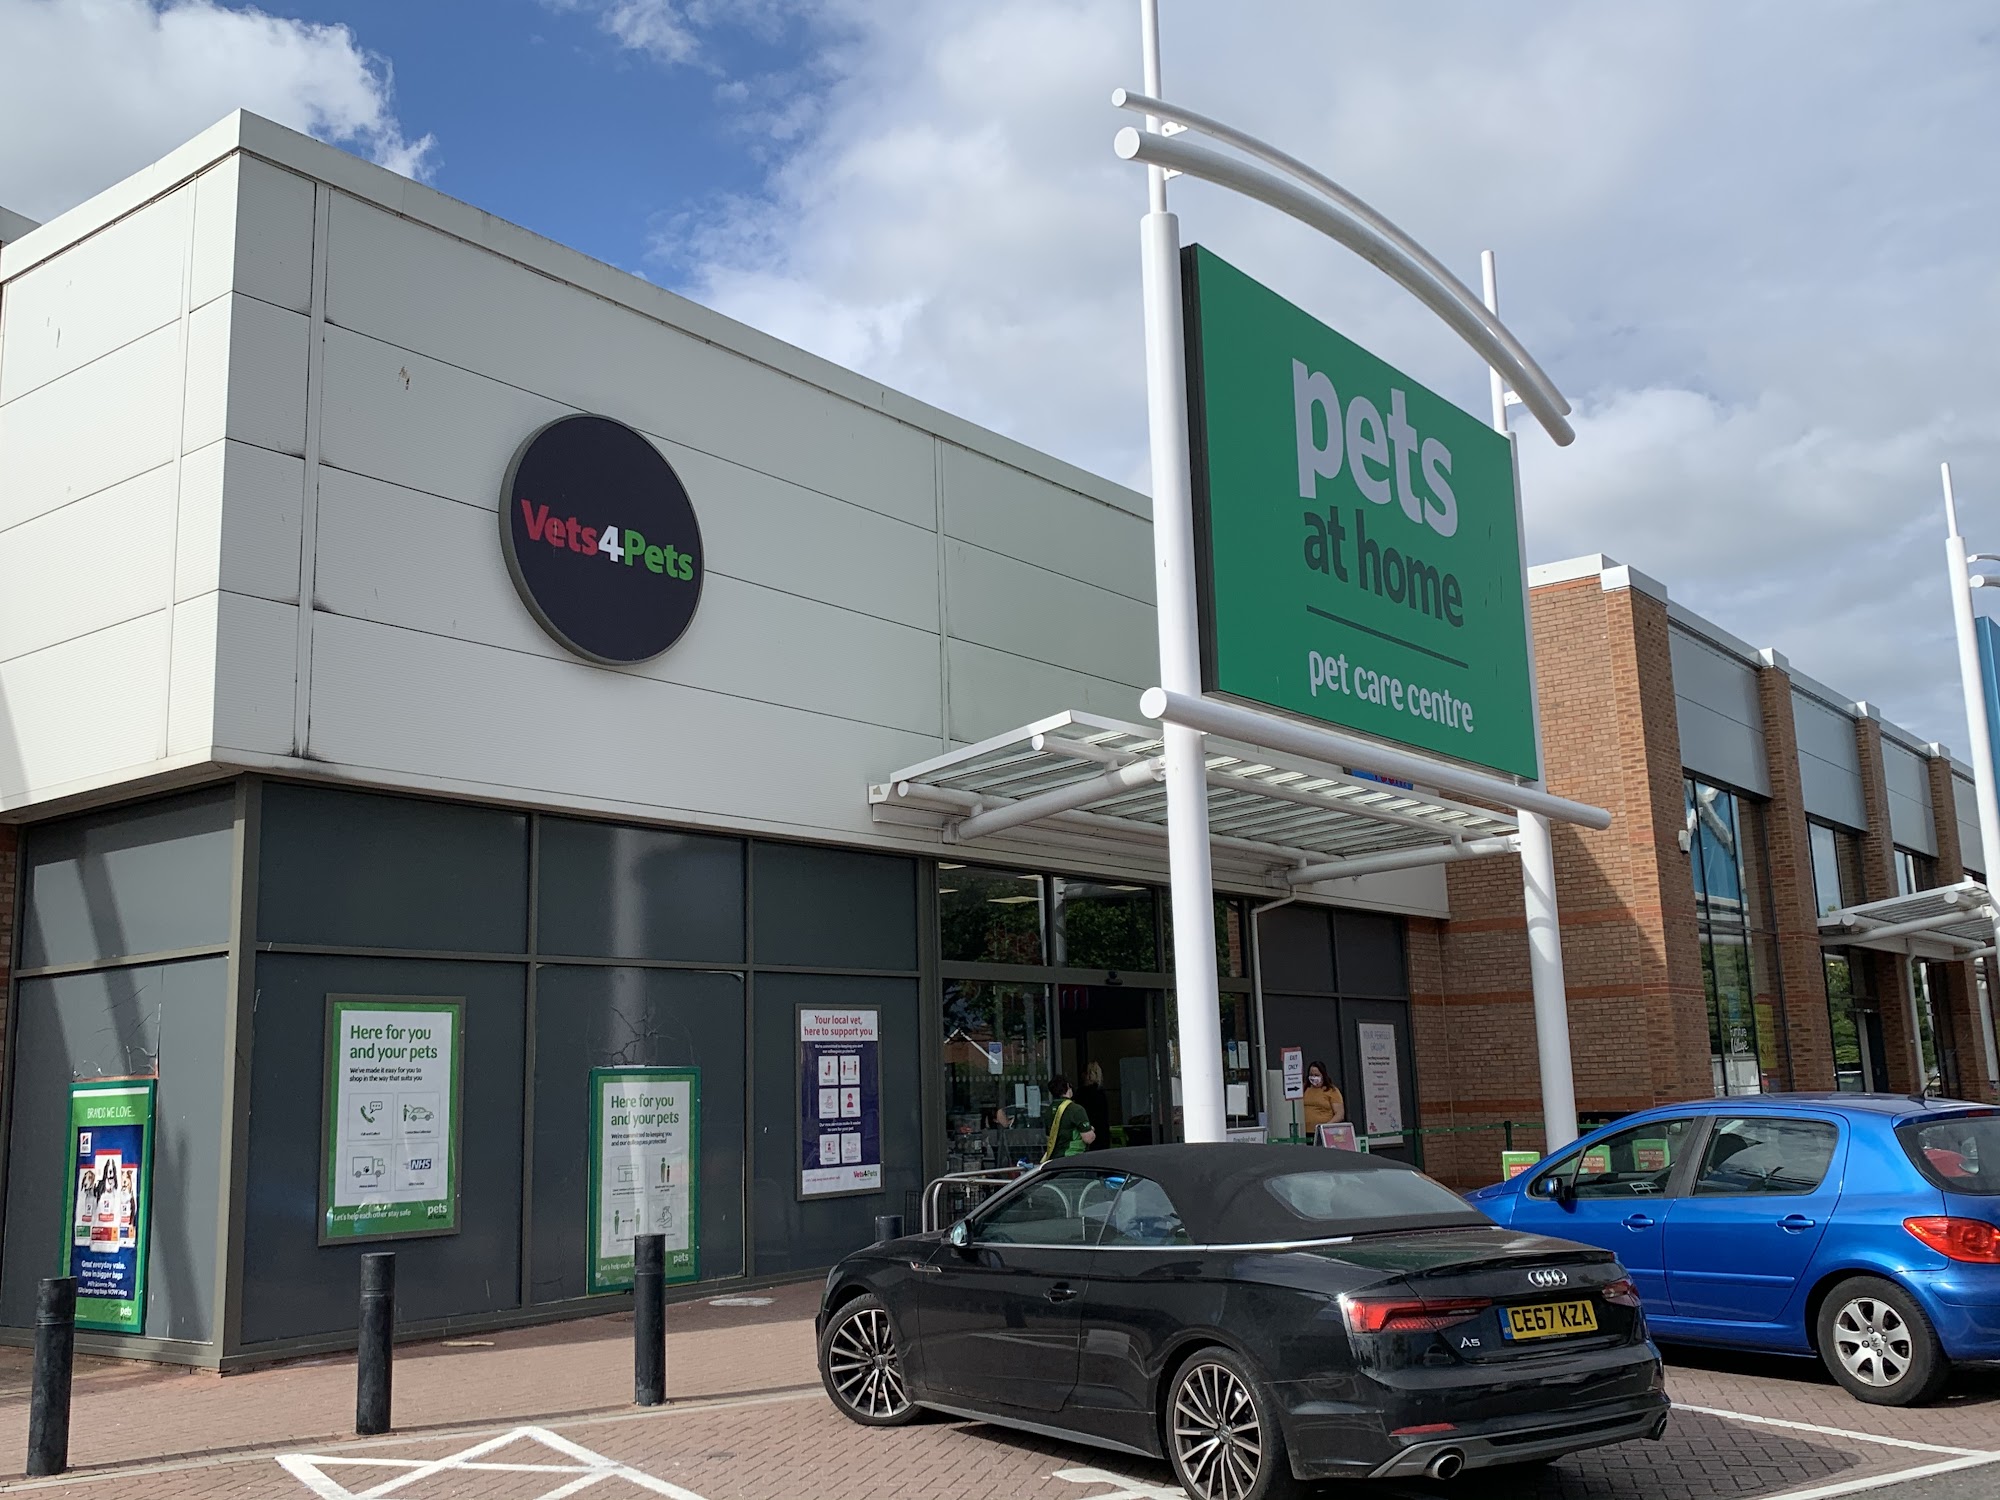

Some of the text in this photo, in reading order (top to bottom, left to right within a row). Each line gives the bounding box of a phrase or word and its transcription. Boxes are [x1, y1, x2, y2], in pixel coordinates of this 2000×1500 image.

[1291, 357, 1459, 538] pets
[520, 499, 694, 581] Vets4Pets
[1303, 504, 1464, 628] at home
[1308, 649, 1474, 733] pet care centre
[814, 1015, 831, 1024] Your
[831, 1015, 849, 1024] local
[350, 1024, 431, 1043] Here for you
[804, 1026, 873, 1037] here to support you
[350, 1043, 438, 1062] and your pets
[397, 1066, 406, 1074] for
[349, 1075, 362, 1083] shop
[611, 1093, 674, 1110] Here for you
[106, 1106, 115, 1118] WE
[611, 1111, 679, 1128] and your pets
[411, 1159, 431, 1170] NHS
[853, 1170, 878, 1178] Vets4Pets
[334, 1213, 346, 1221] Let's
[346, 1212, 359, 1221] help
[359, 1211, 372, 1219] each
[388, 1210, 399, 1219] stay
[399, 1208, 411, 1217] safe
[427, 1203, 447, 1216] pets
[673, 1253, 689, 1264] pets
[610, 1263, 620, 1271] help
[112, 1271, 123, 1280] bags
[1511, 1303, 1593, 1332] CE67 KZA
[1460, 1336, 1481, 1349] A5
